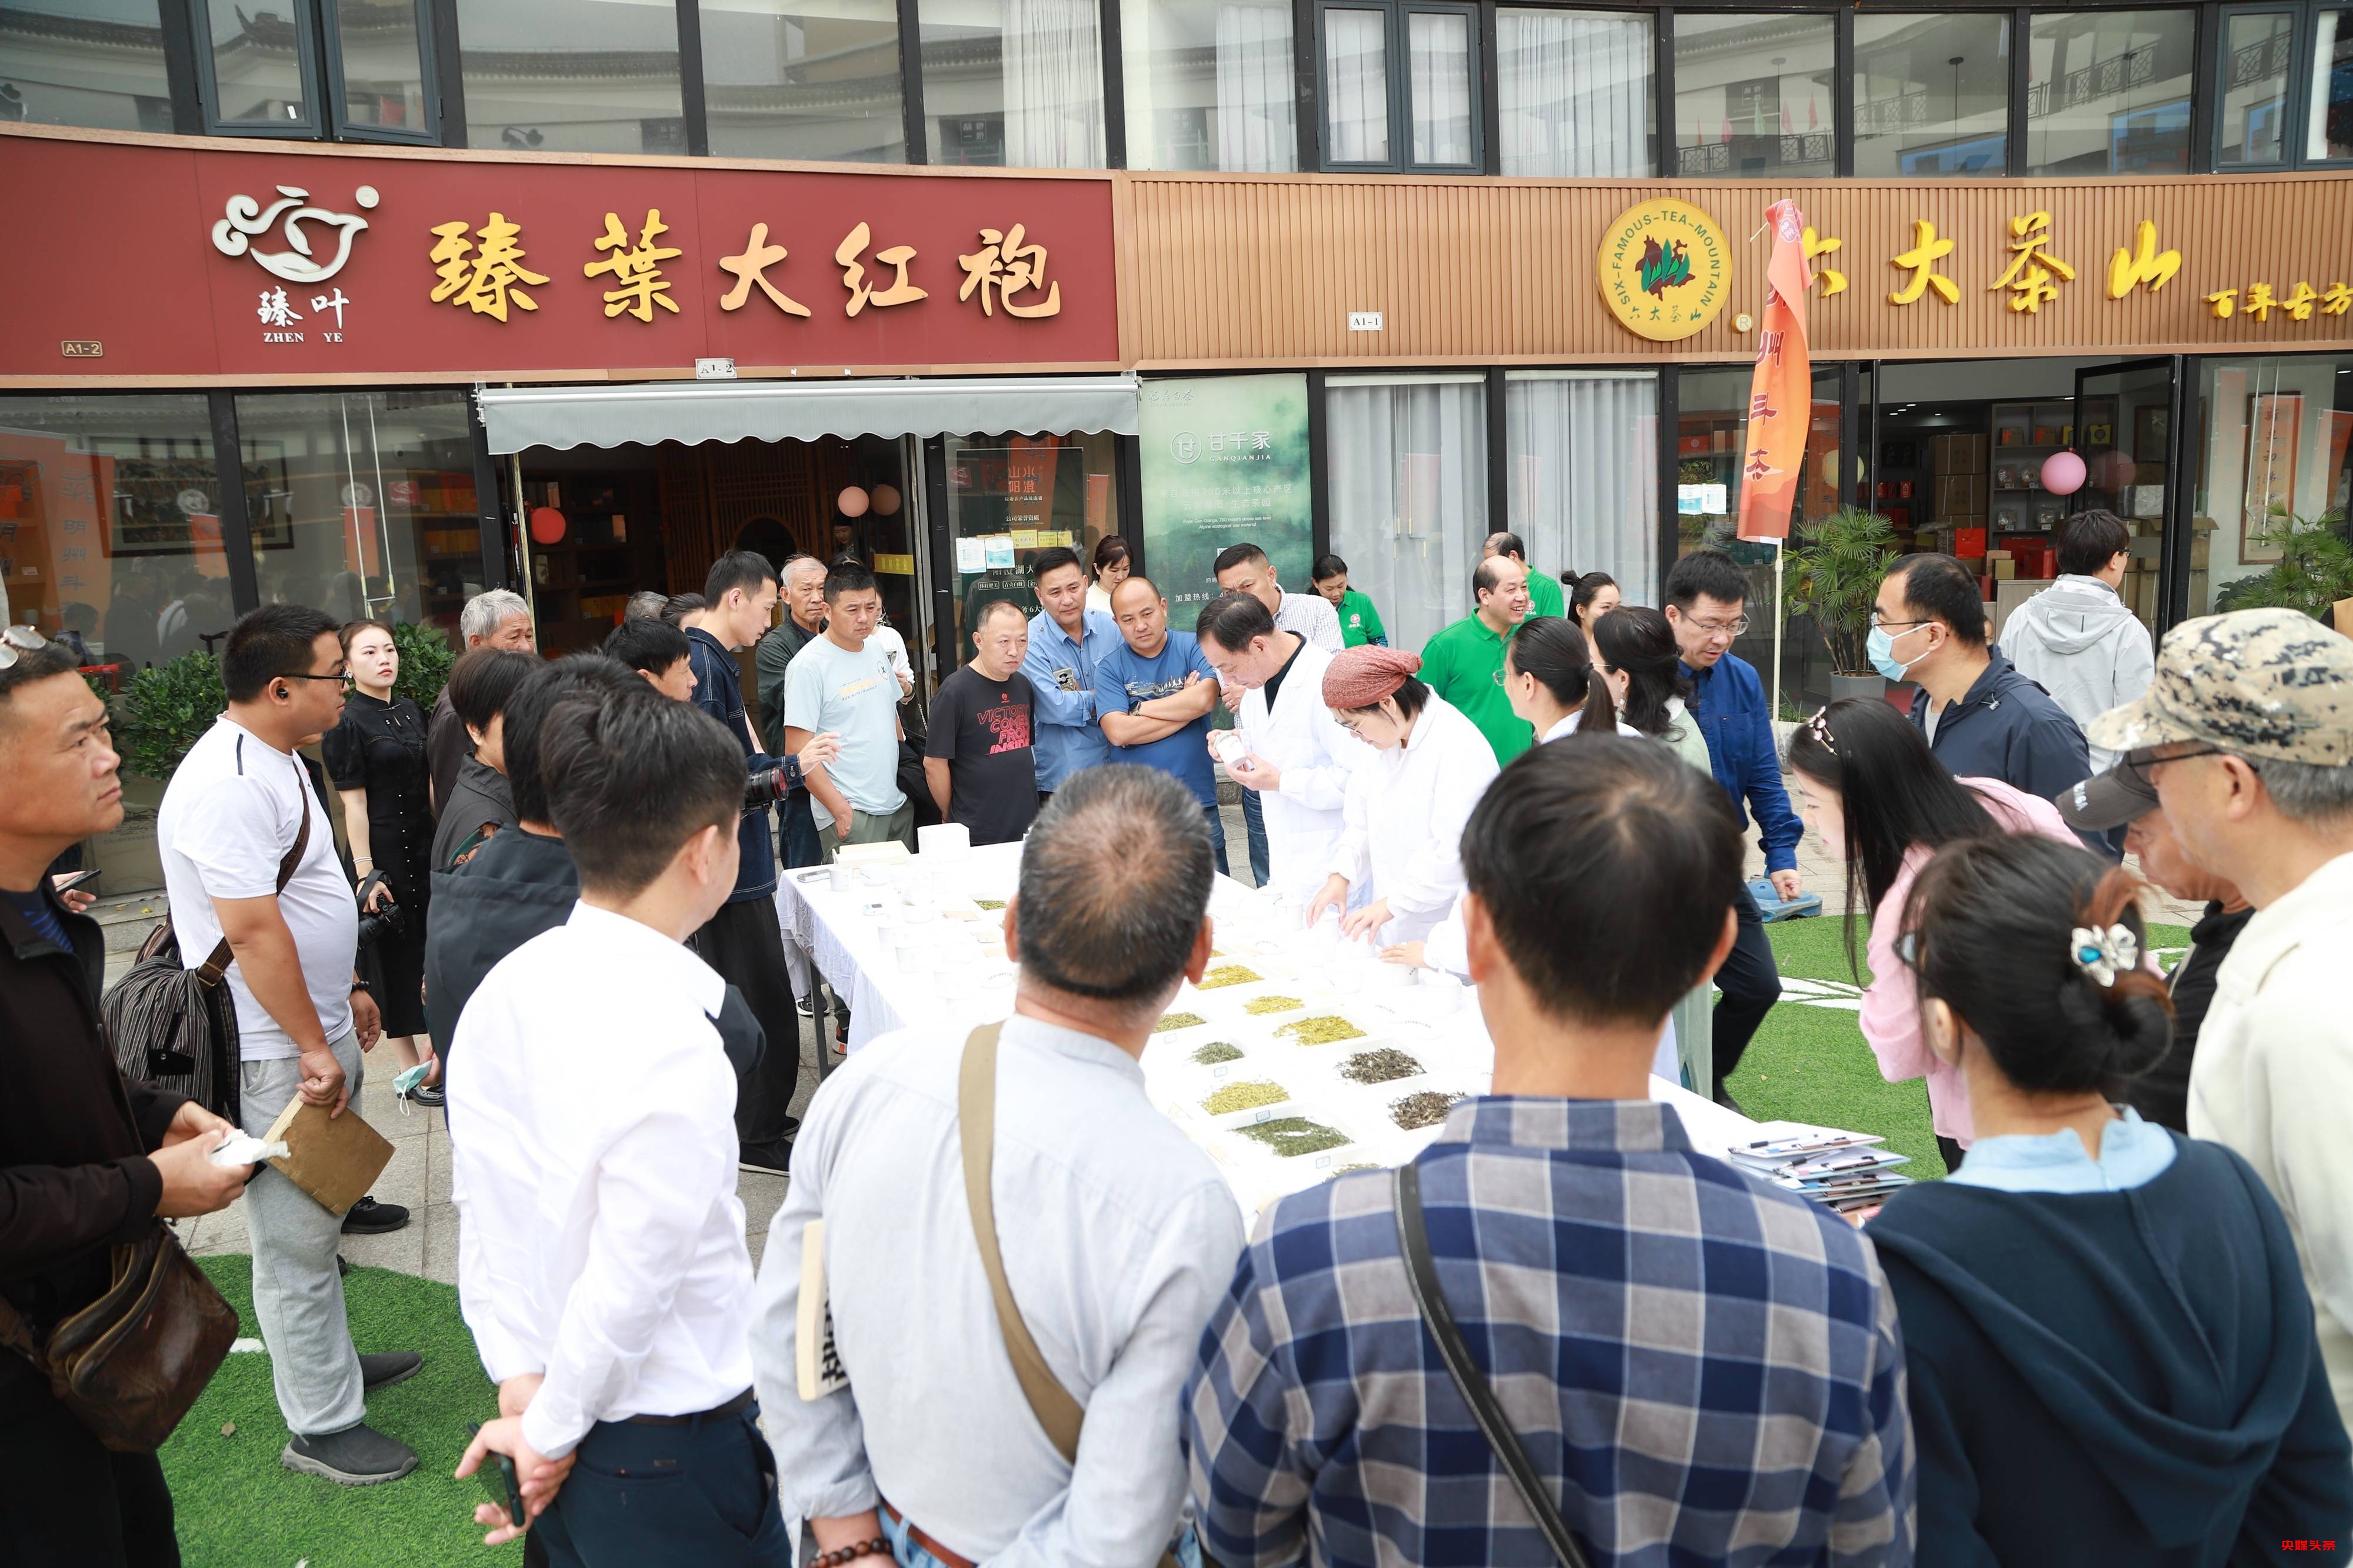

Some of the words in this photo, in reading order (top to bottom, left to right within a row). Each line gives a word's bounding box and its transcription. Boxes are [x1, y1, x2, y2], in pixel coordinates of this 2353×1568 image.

[429, 208, 1061, 322] 臻葉大红袍
[257, 285, 350, 329] 臻叶
[2202, 281, 2353, 322] 百年古方
[1629, 305, 1701, 323] 六大茶山
[264, 332, 304, 342] ZHEN
[323, 332, 343, 342] YE
[65, 343, 100, 354] A1-2
[1207, 431, 1271, 452] 甘千家
[1209, 454, 1271, 462] GANQIANJIA
[977, 704, 1029, 725] VICTORY
